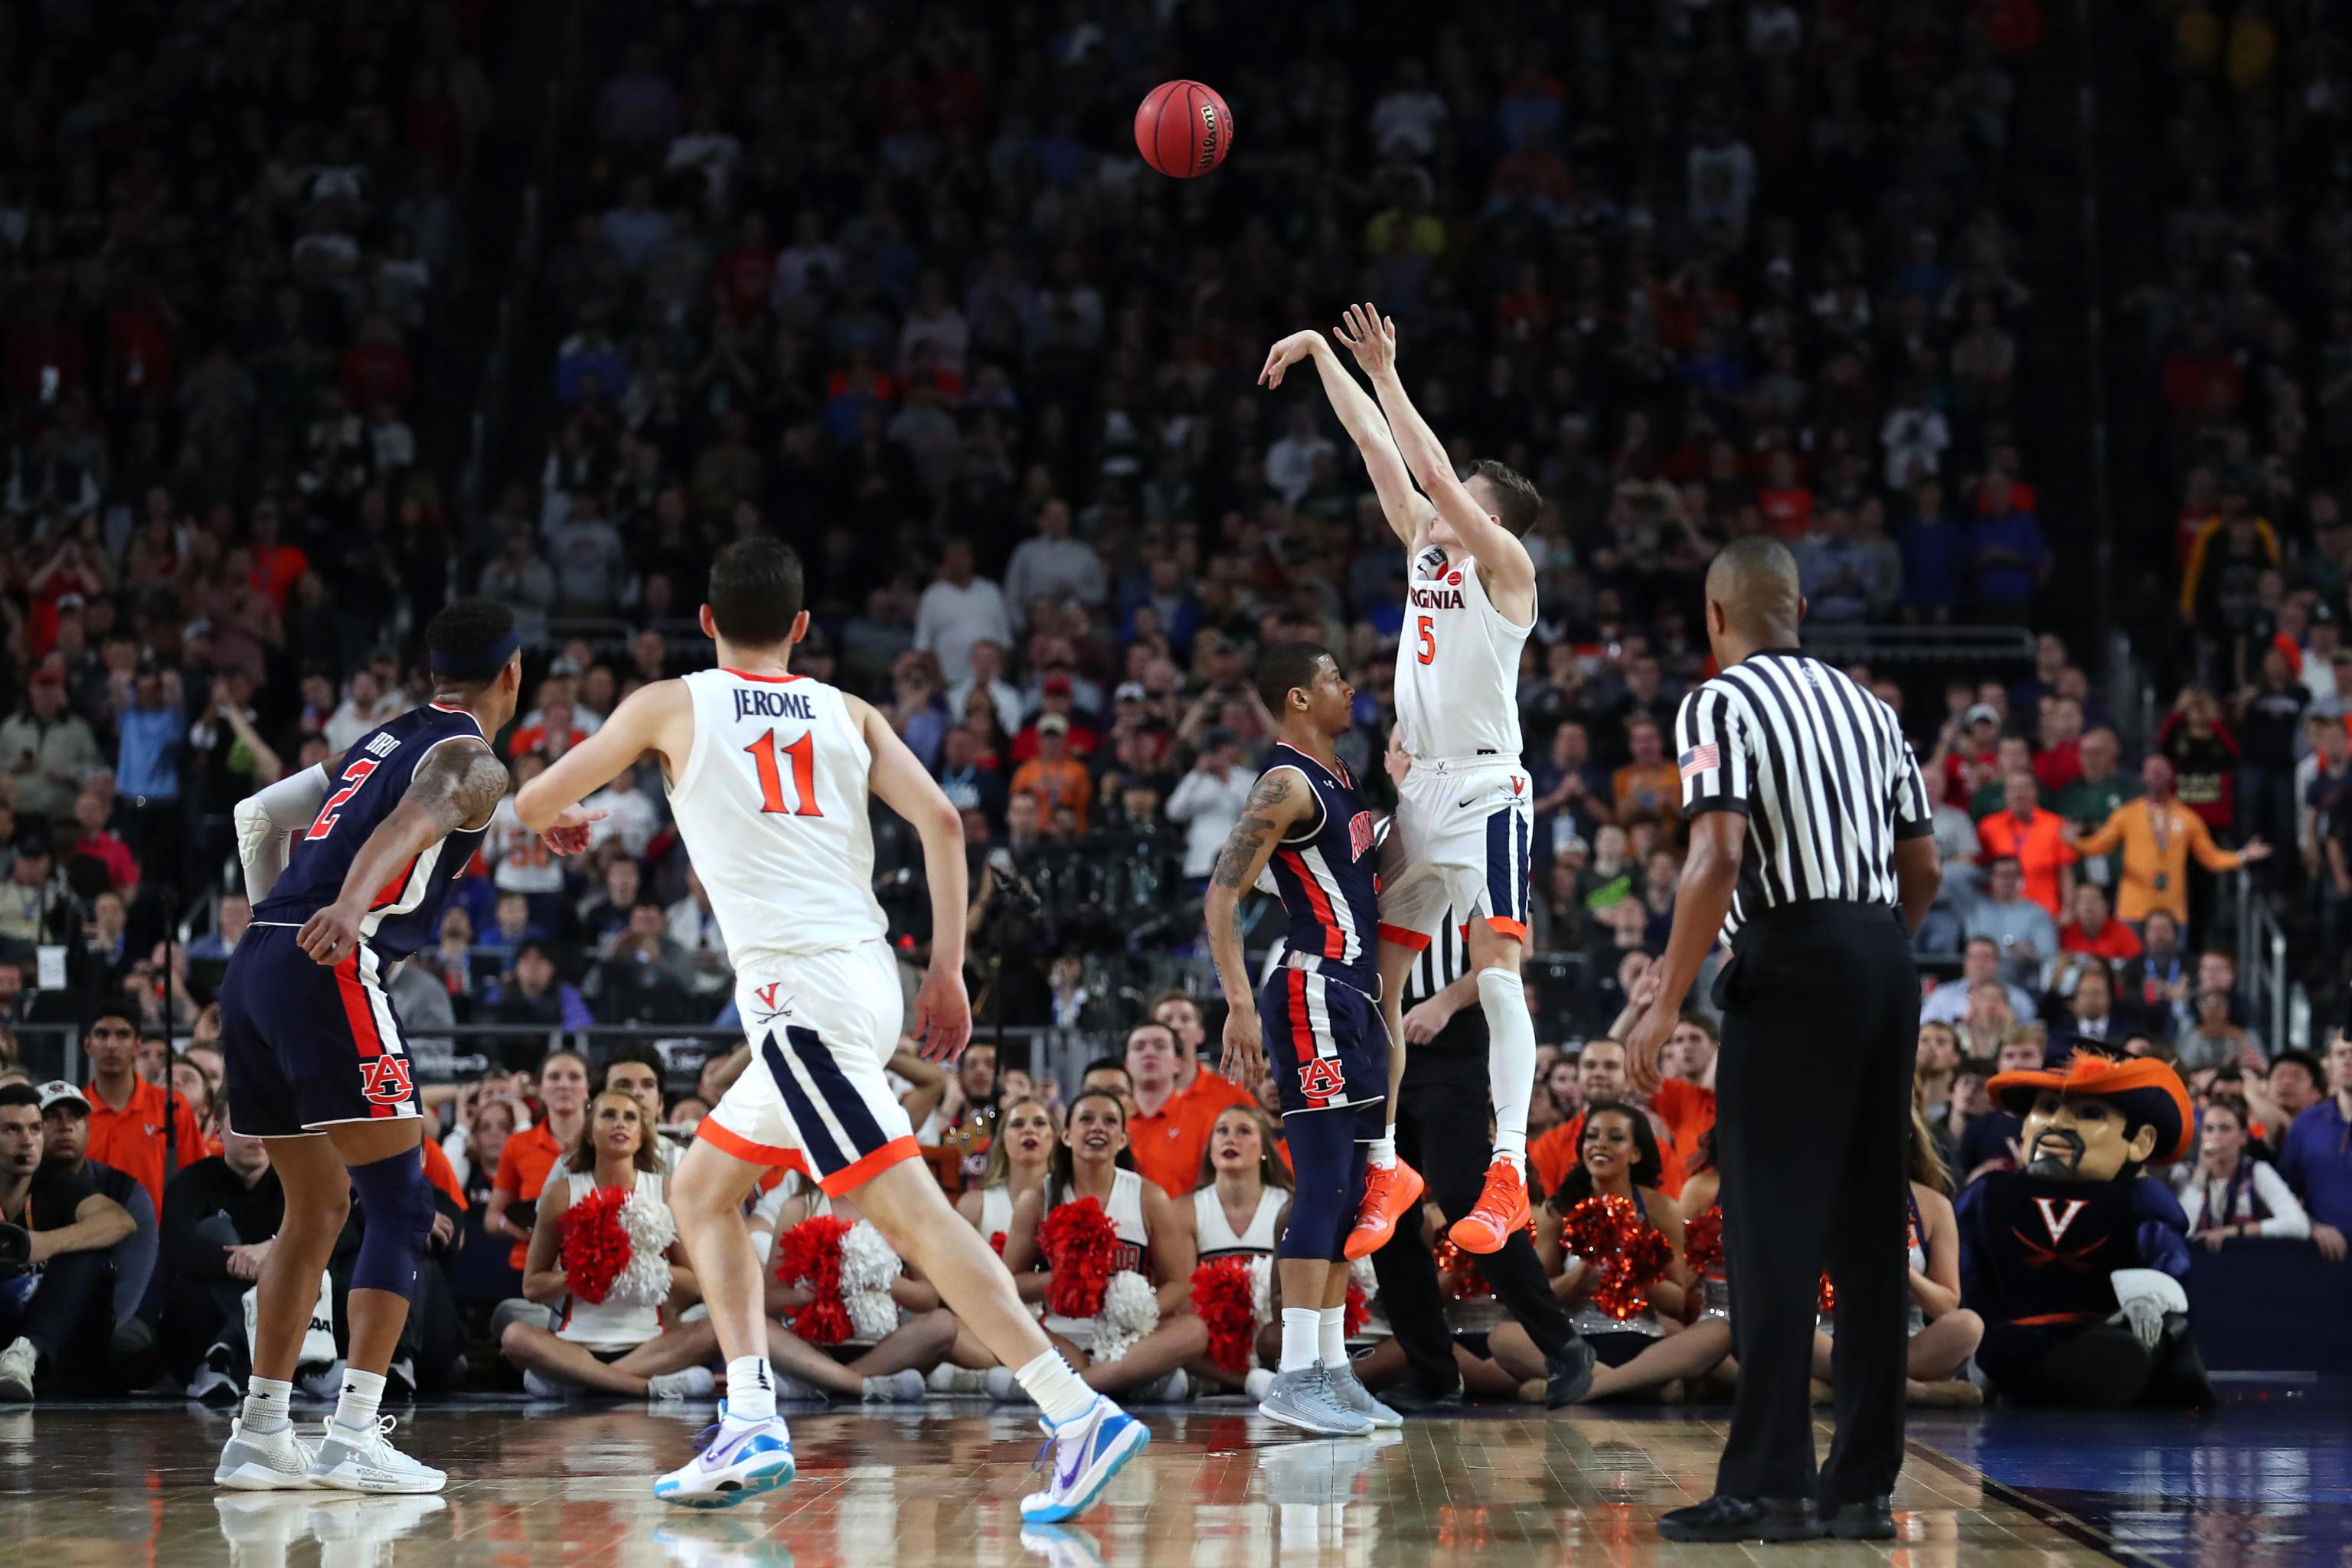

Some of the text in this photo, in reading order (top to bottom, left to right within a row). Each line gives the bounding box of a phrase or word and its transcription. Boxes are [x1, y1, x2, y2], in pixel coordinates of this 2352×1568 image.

[1198, 104, 1217, 168] Wilson
[1417, 616, 1436, 665] 5
[733, 688, 816, 723] JEROME
[743, 727, 825, 818] 11
[1510, 775, 1525, 796] V
[304, 757, 381, 841] 2
[753, 982, 781, 1011] V
[2031, 1196, 2089, 1246] V
